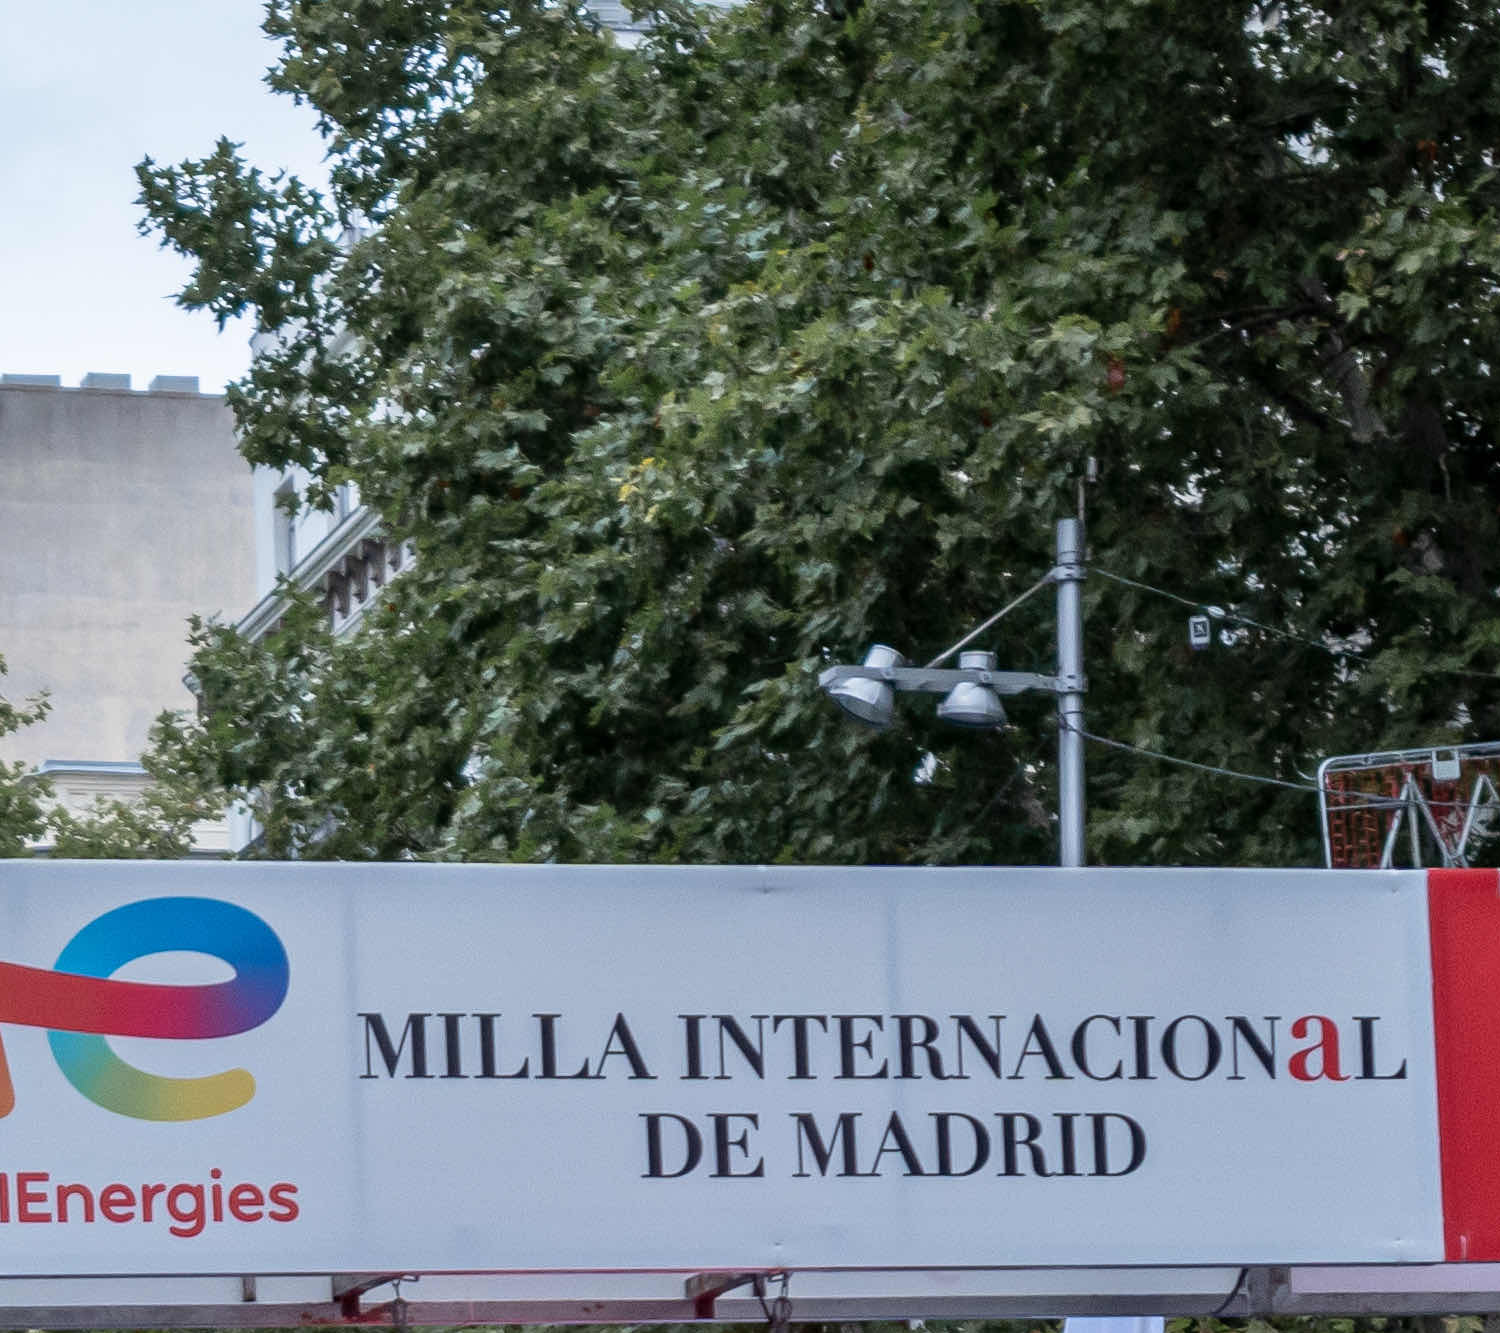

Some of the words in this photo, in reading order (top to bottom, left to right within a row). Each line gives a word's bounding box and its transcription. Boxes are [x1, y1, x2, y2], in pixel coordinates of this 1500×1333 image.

[358, 1011, 660, 1081] MILLA
[637, 1112, 766, 1179] DE
[791, 1112, 1150, 1179] MADRID
